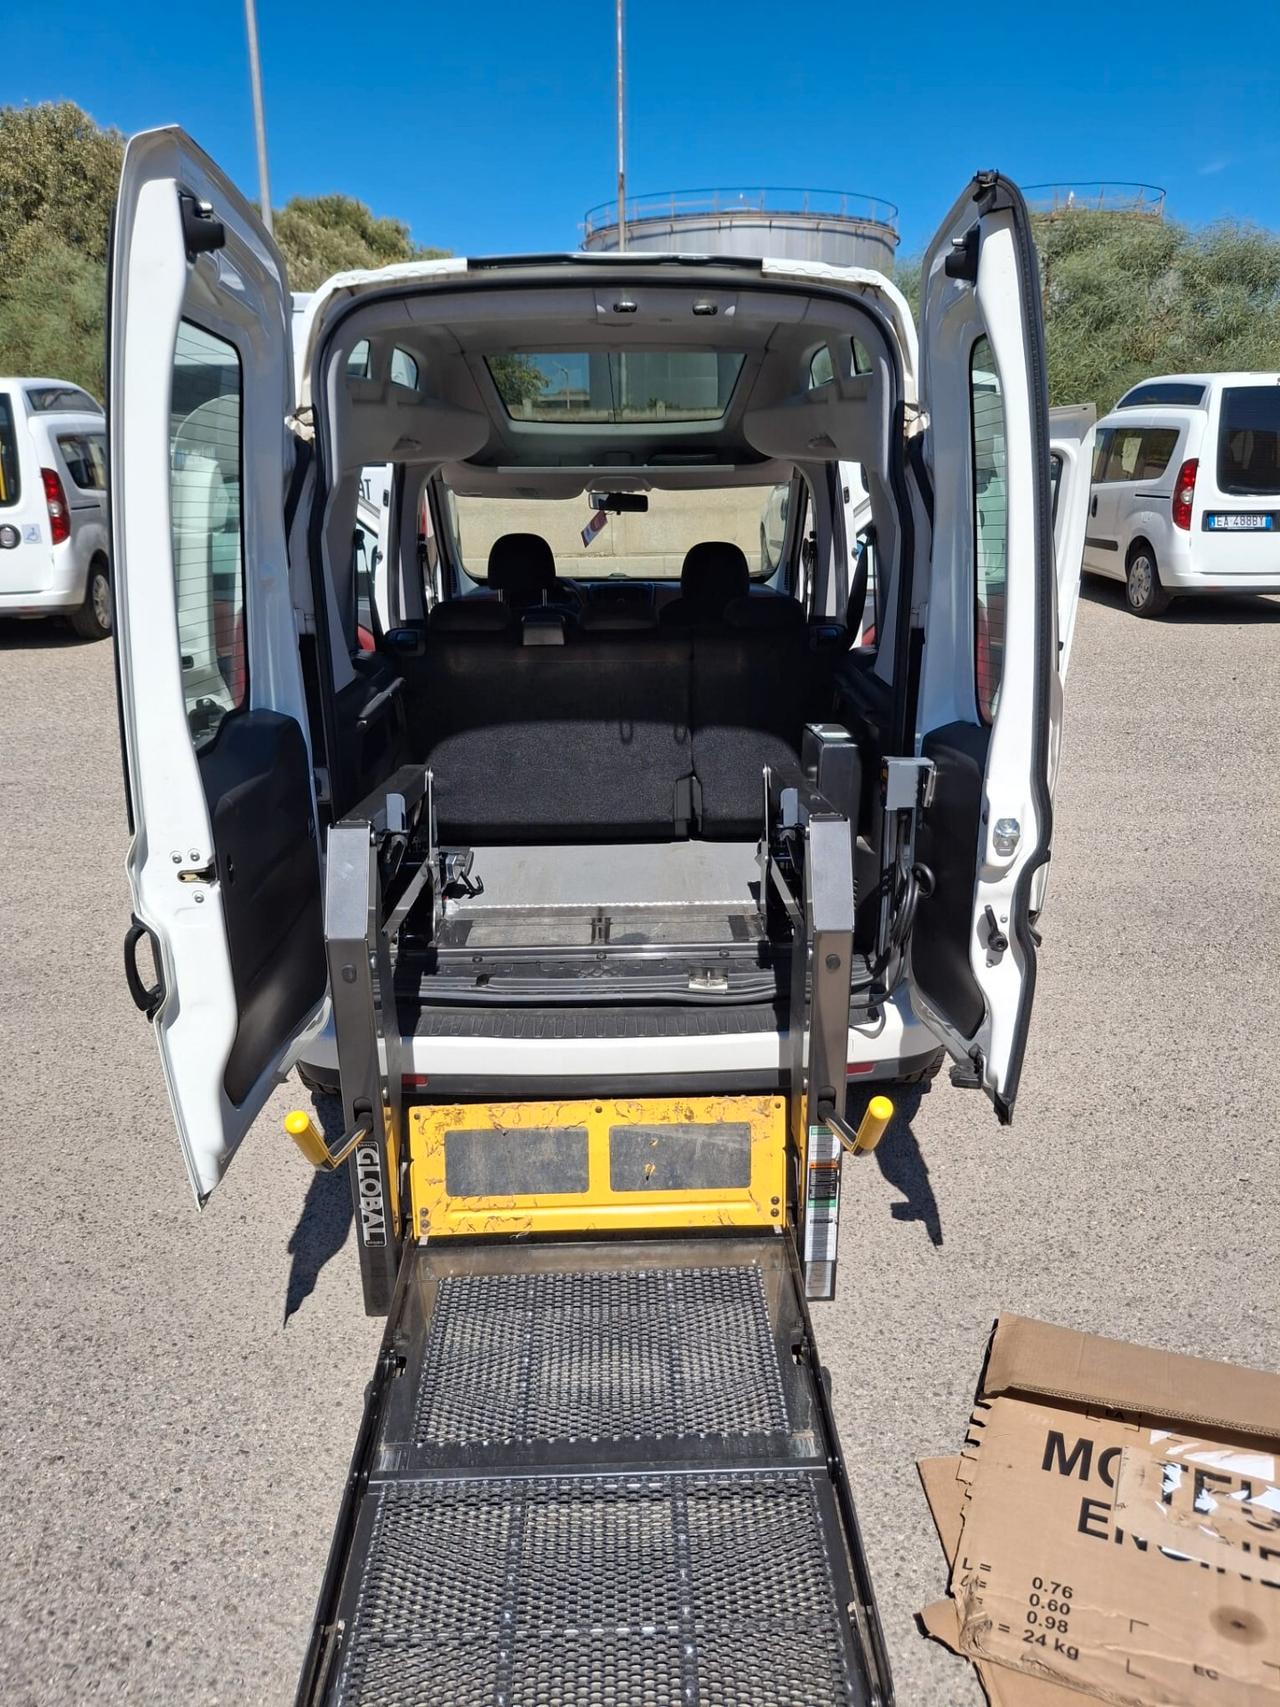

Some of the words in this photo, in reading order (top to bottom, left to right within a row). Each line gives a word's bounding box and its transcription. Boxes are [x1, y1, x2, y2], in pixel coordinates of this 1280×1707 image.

[357, 1147, 385, 1241] GLOBAL
[962, 1557, 973, 1571] L
[1032, 1577, 1073, 1599] 0.76
[1029, 1593, 1071, 1615] 0.60
[1026, 1611, 1069, 1634] 0.98
[1022, 1629, 1047, 1647] 24
[1054, 1638, 1080, 1661] kg
